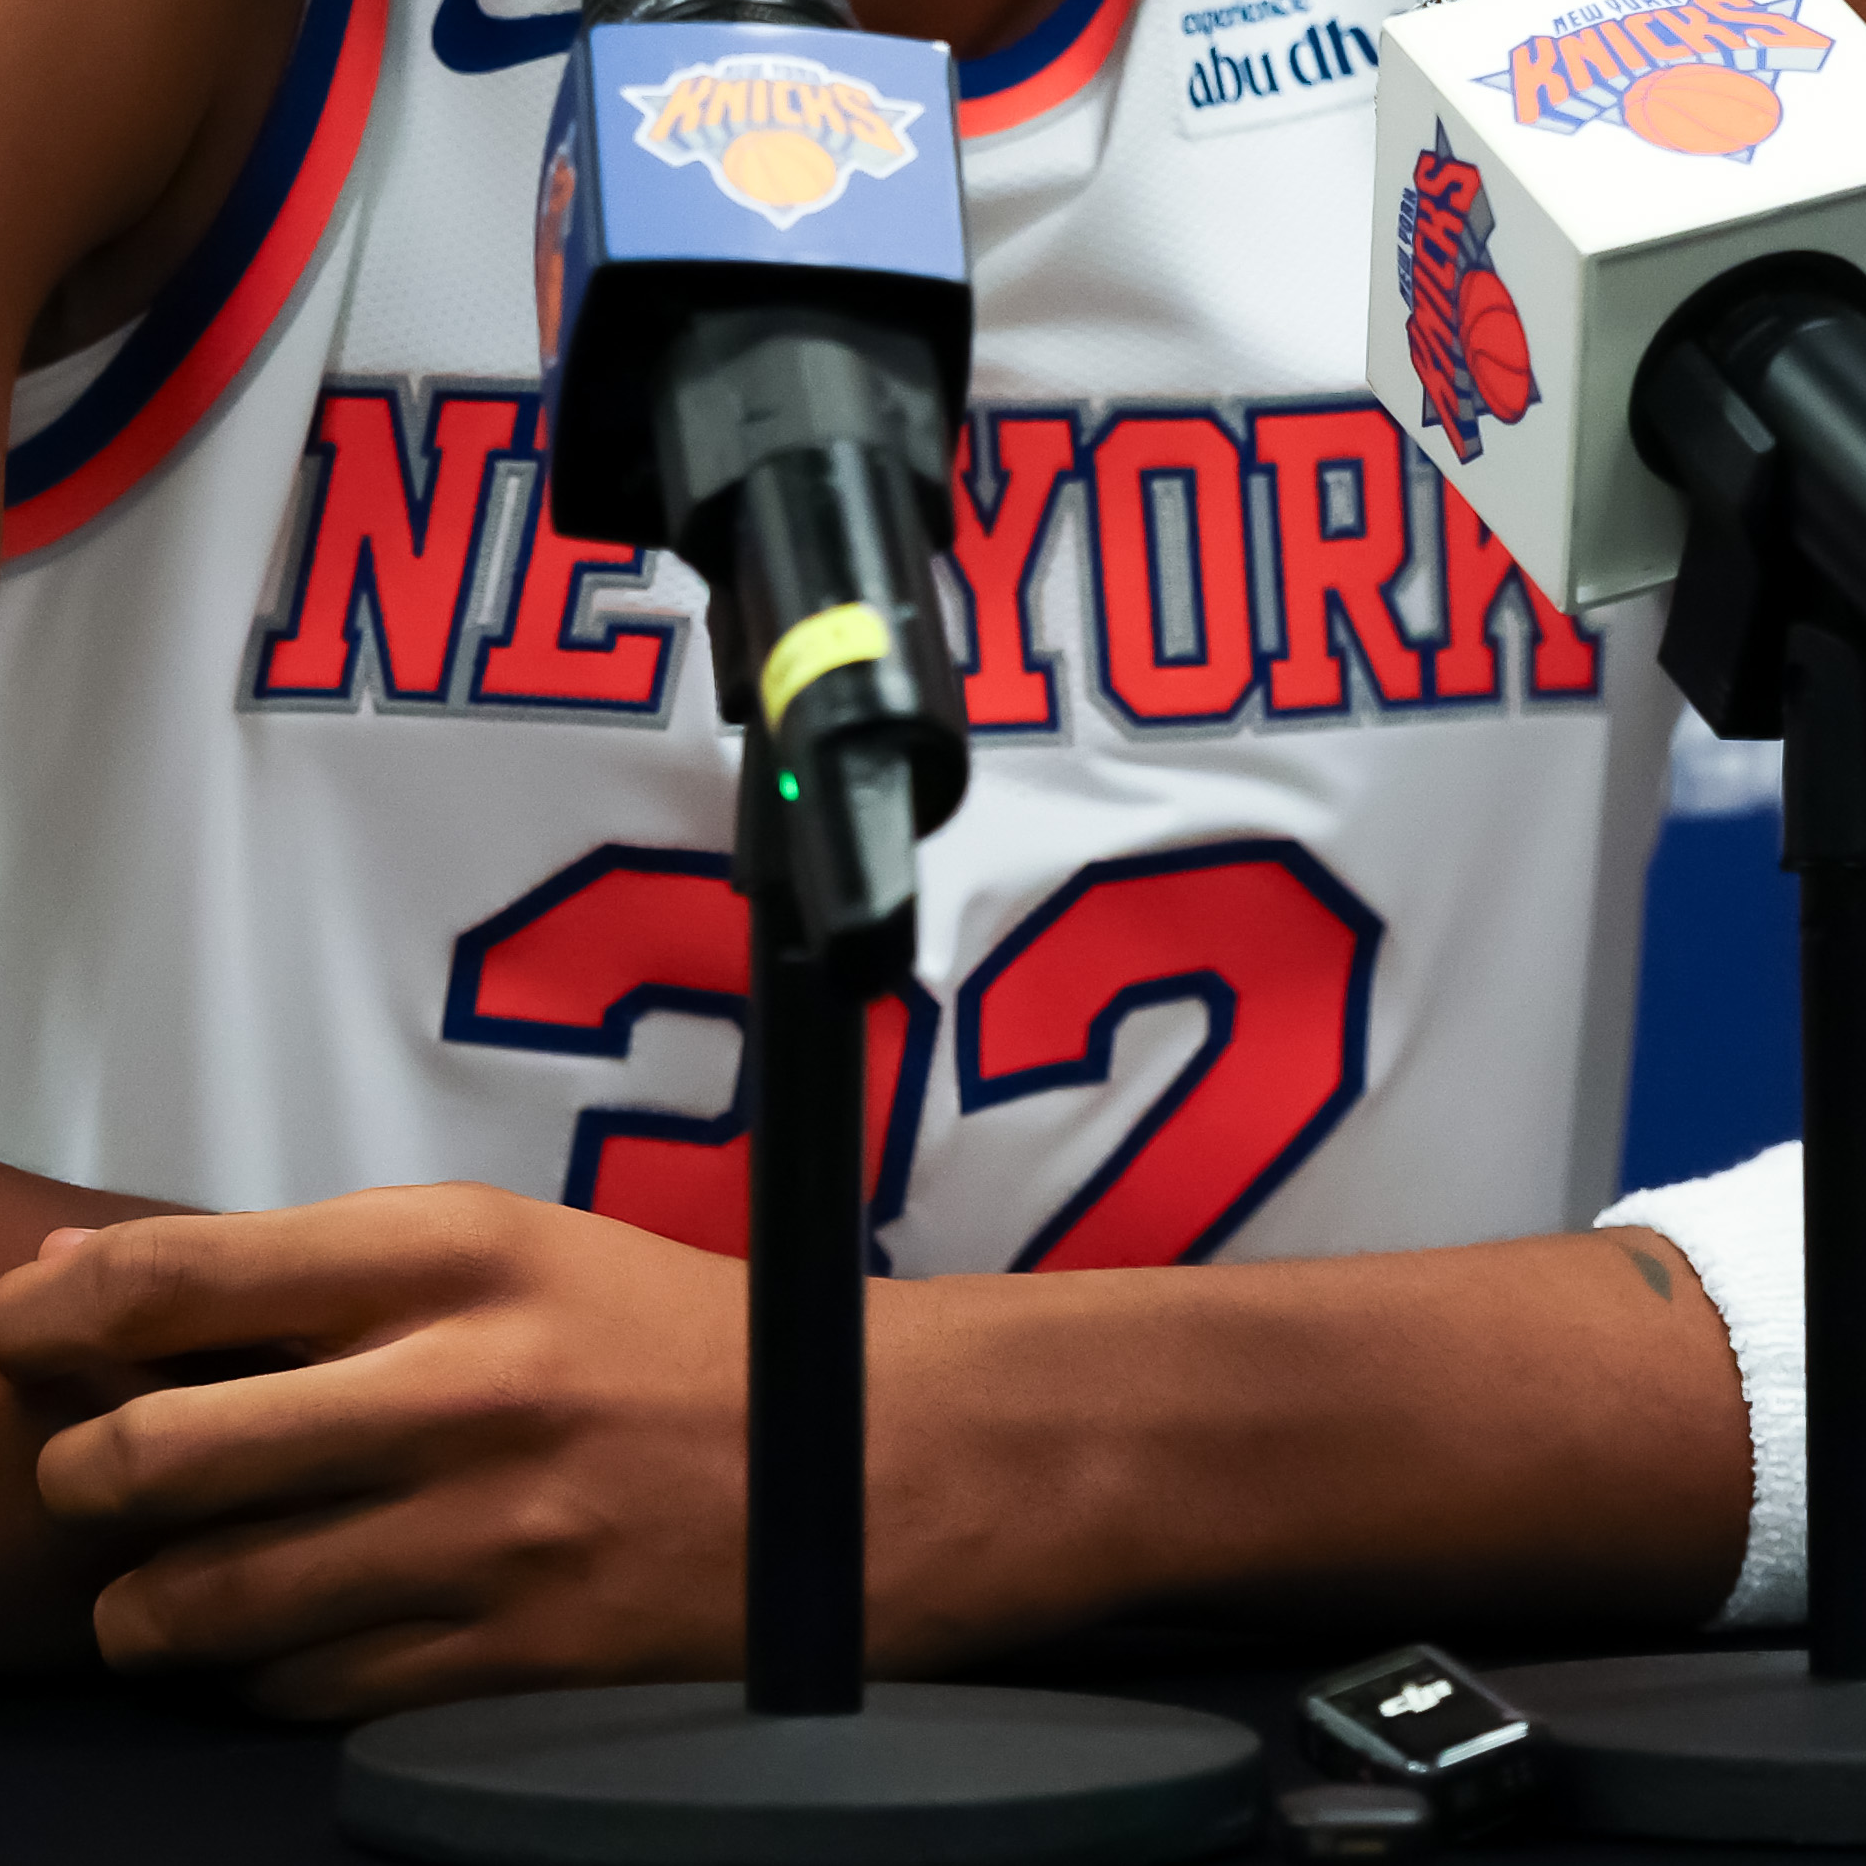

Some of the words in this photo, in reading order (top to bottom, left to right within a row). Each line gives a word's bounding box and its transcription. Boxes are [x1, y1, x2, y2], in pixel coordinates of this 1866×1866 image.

[1189, 46, 1280, 109] abu
[1289, 18, 1380, 86] dh
[1552, 3, 1604, 34] NEW
[648, 75, 905, 156] KNICKS
[1405, 149, 1483, 464] KNICKS
[246, 382, 682, 719] NE
